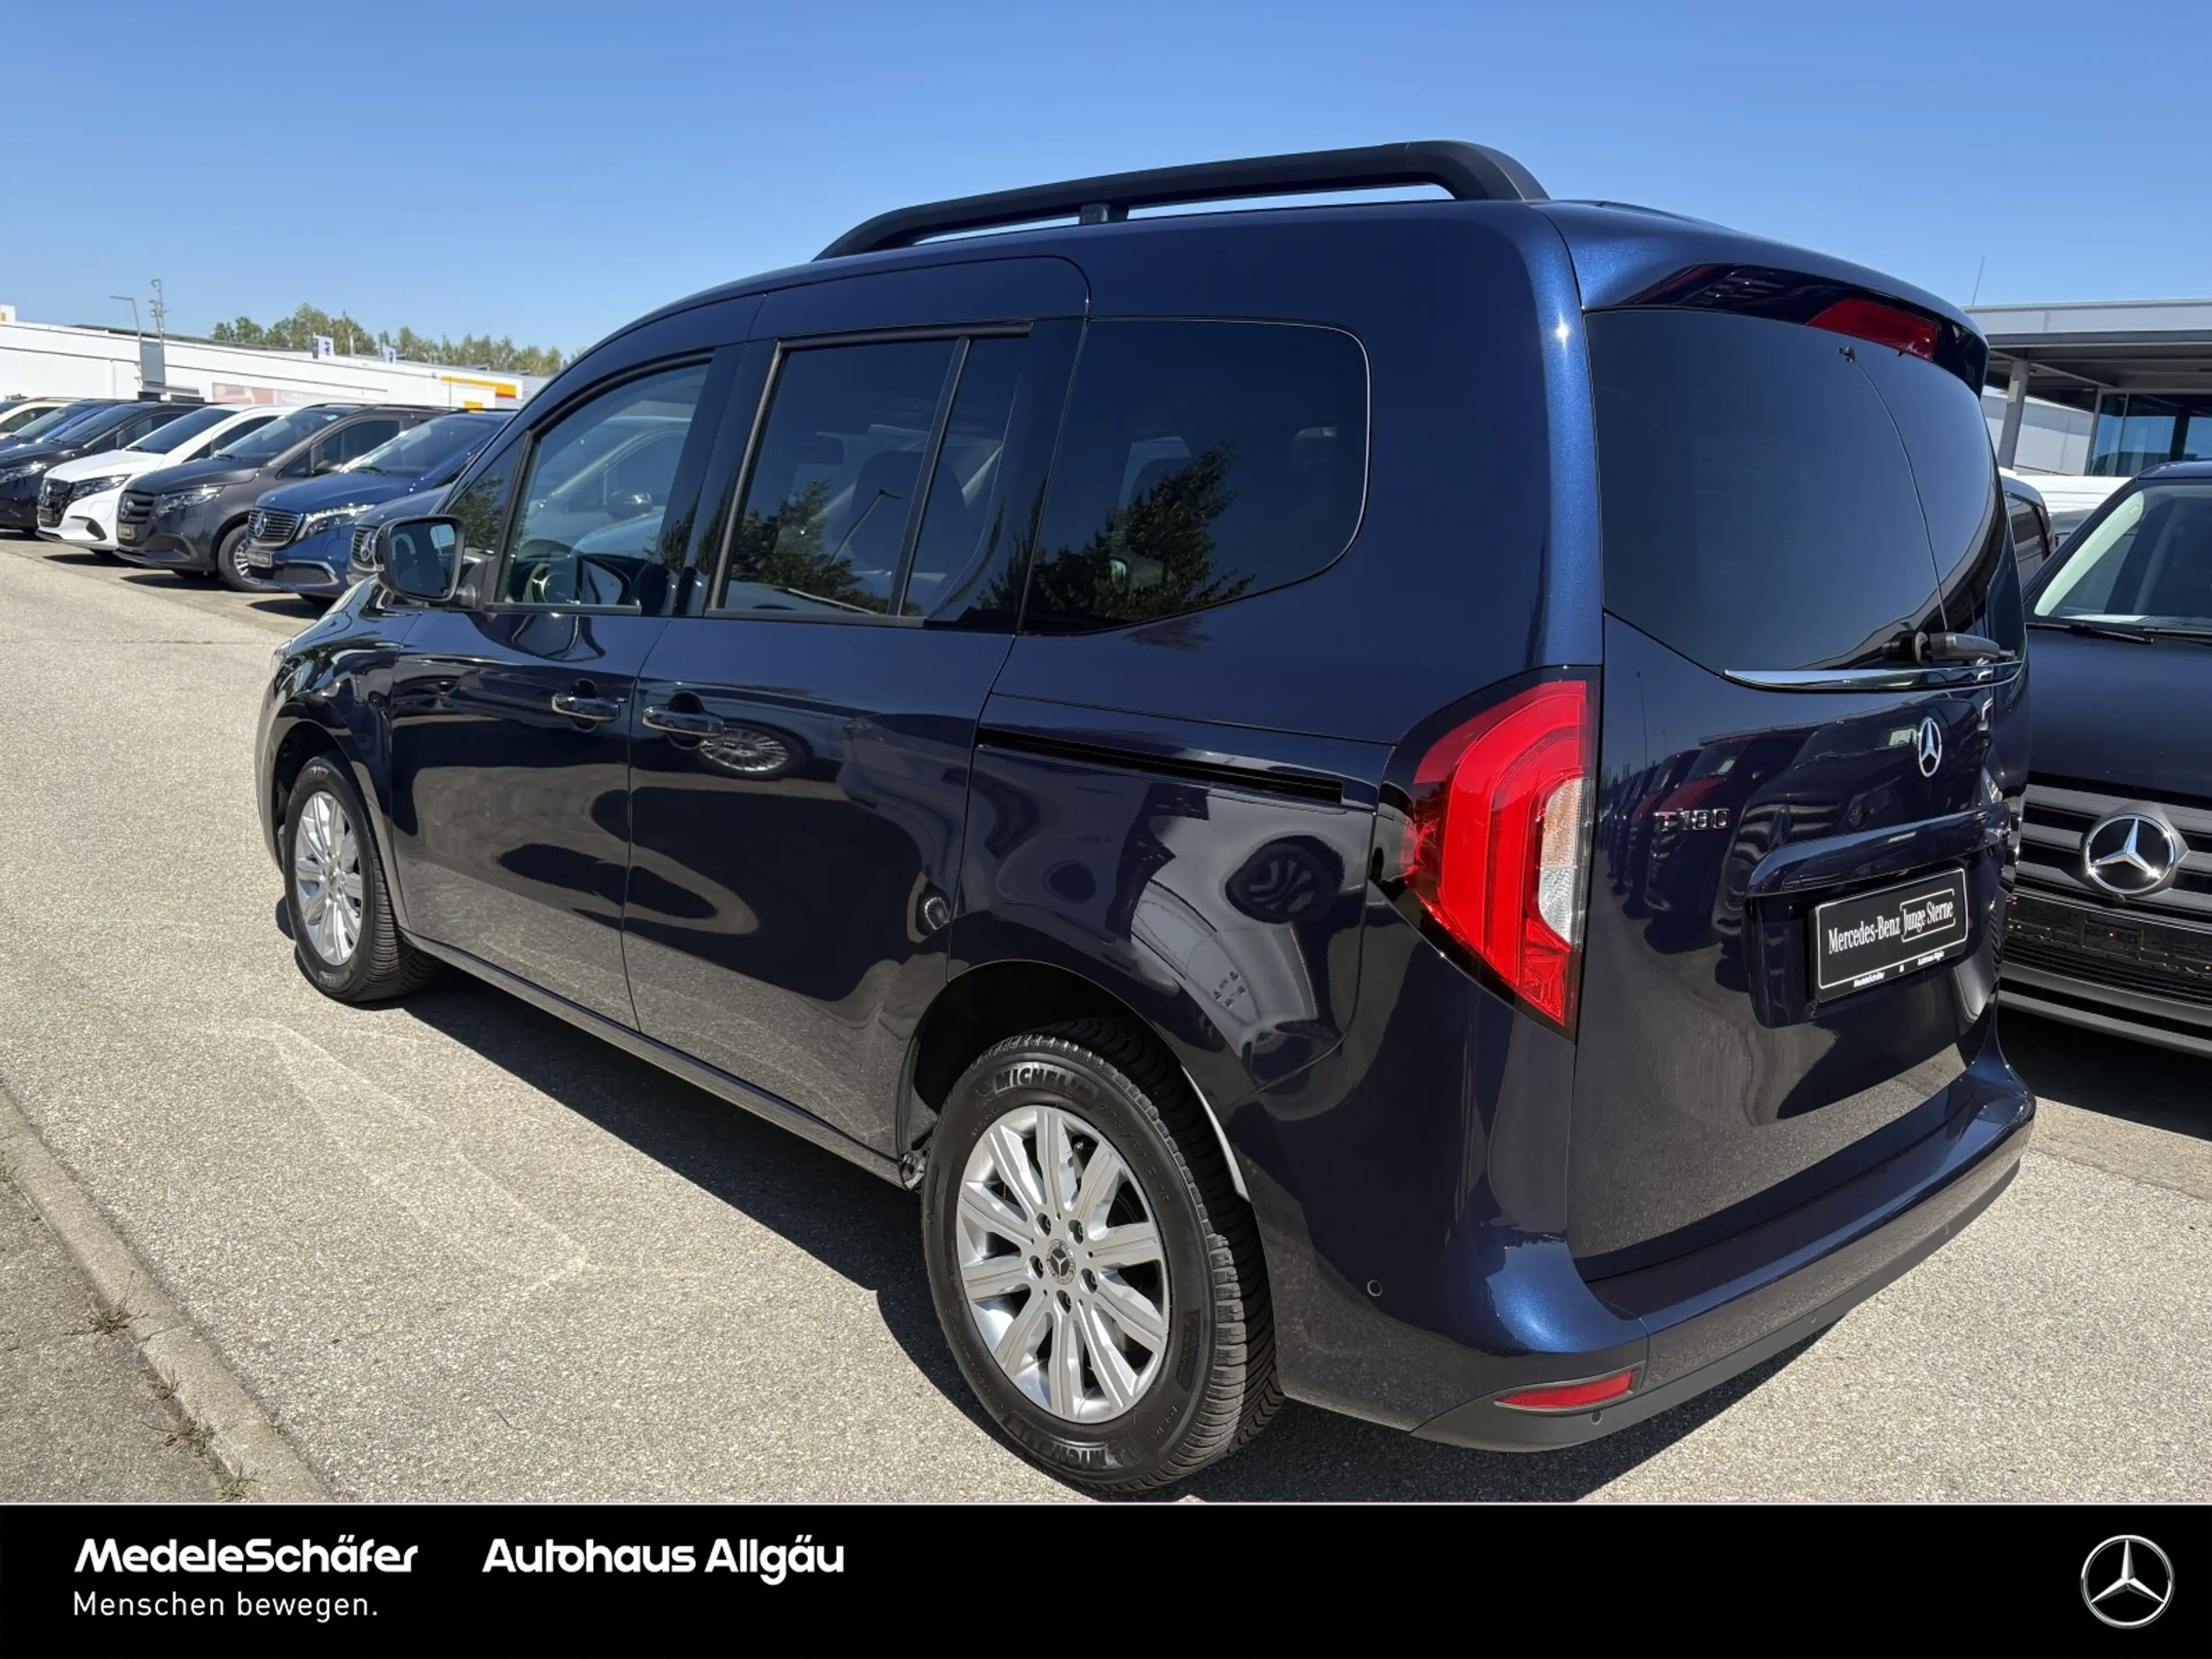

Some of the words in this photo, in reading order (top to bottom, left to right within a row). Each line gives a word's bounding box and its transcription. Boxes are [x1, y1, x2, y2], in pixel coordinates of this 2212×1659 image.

[1828, 915, 1900, 955] Mercedes-Benz
[1903, 908, 1925, 936] Junge
[1927, 902, 1953, 924] Sterne
